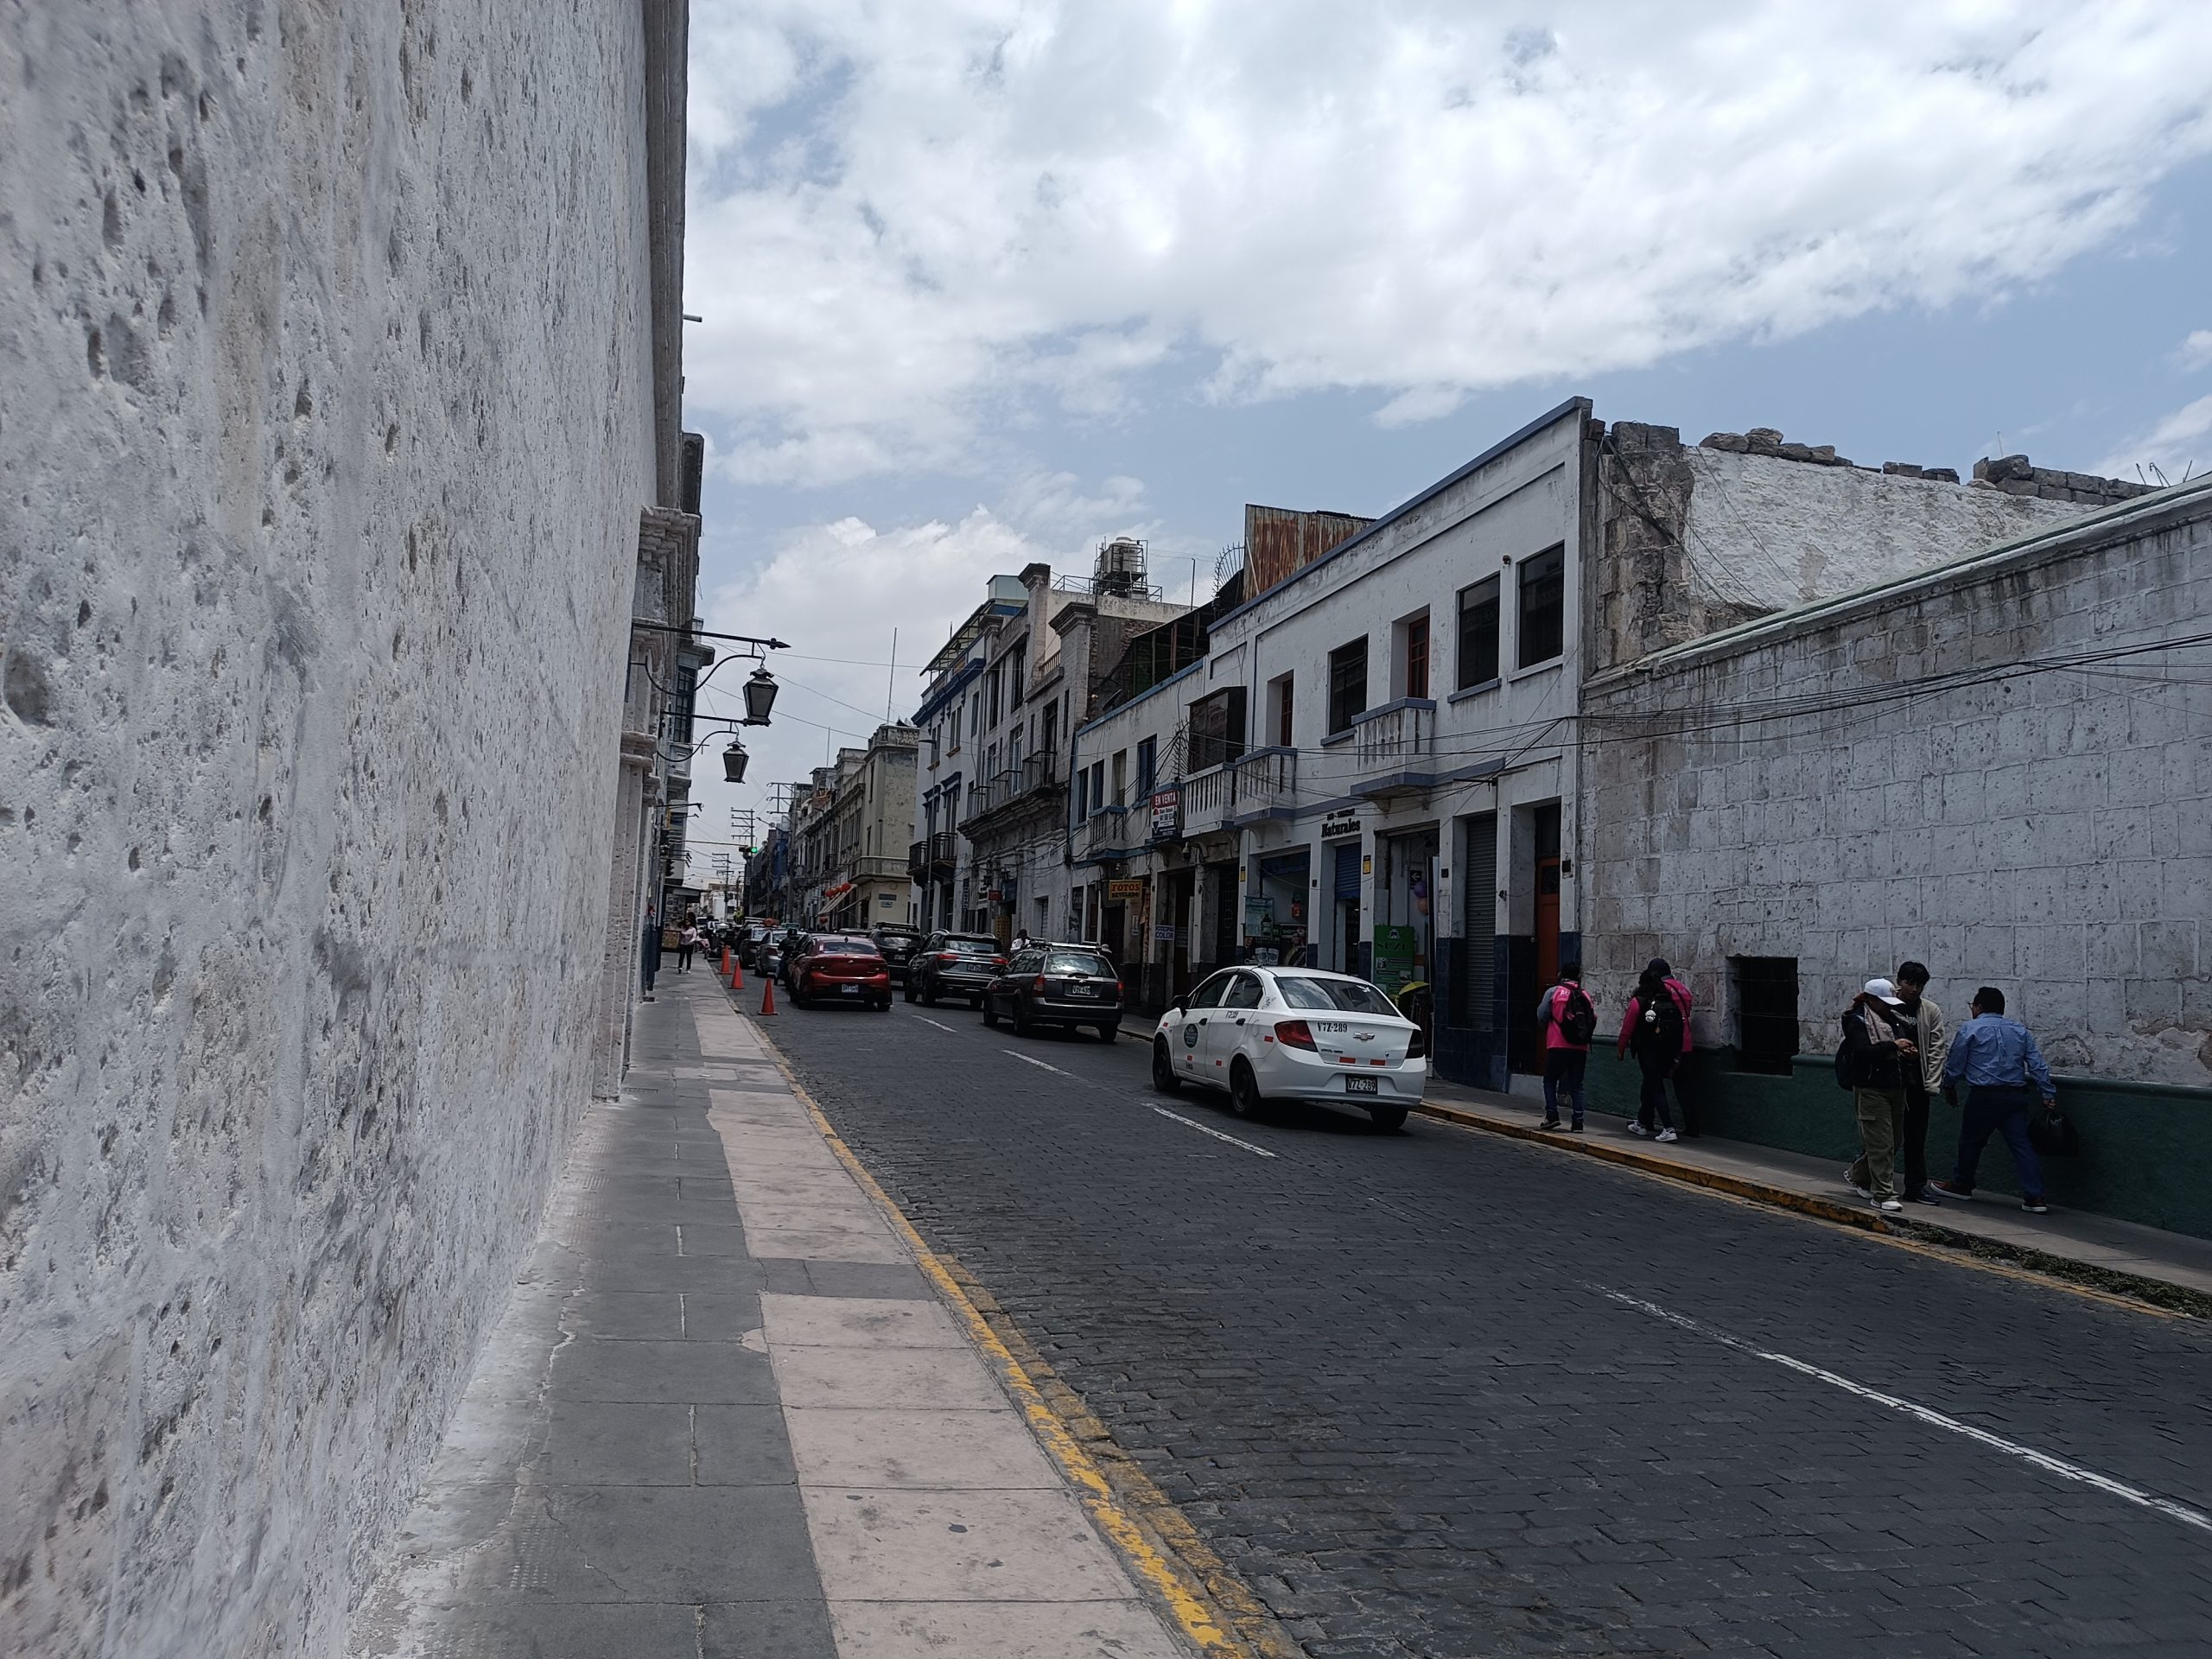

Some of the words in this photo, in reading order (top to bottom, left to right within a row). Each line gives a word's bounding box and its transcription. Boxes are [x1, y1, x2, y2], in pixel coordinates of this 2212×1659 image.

[1155, 795, 1161, 806] EN
[1161, 791, 1176, 804] VENTA
[1321, 818, 1361, 838] Naturales
[1111, 883, 1140, 892] FOTOS
[1317, 1022, 1348, 1033] V7Z-289
[1348, 1077, 1376, 1091] V7Z-289
